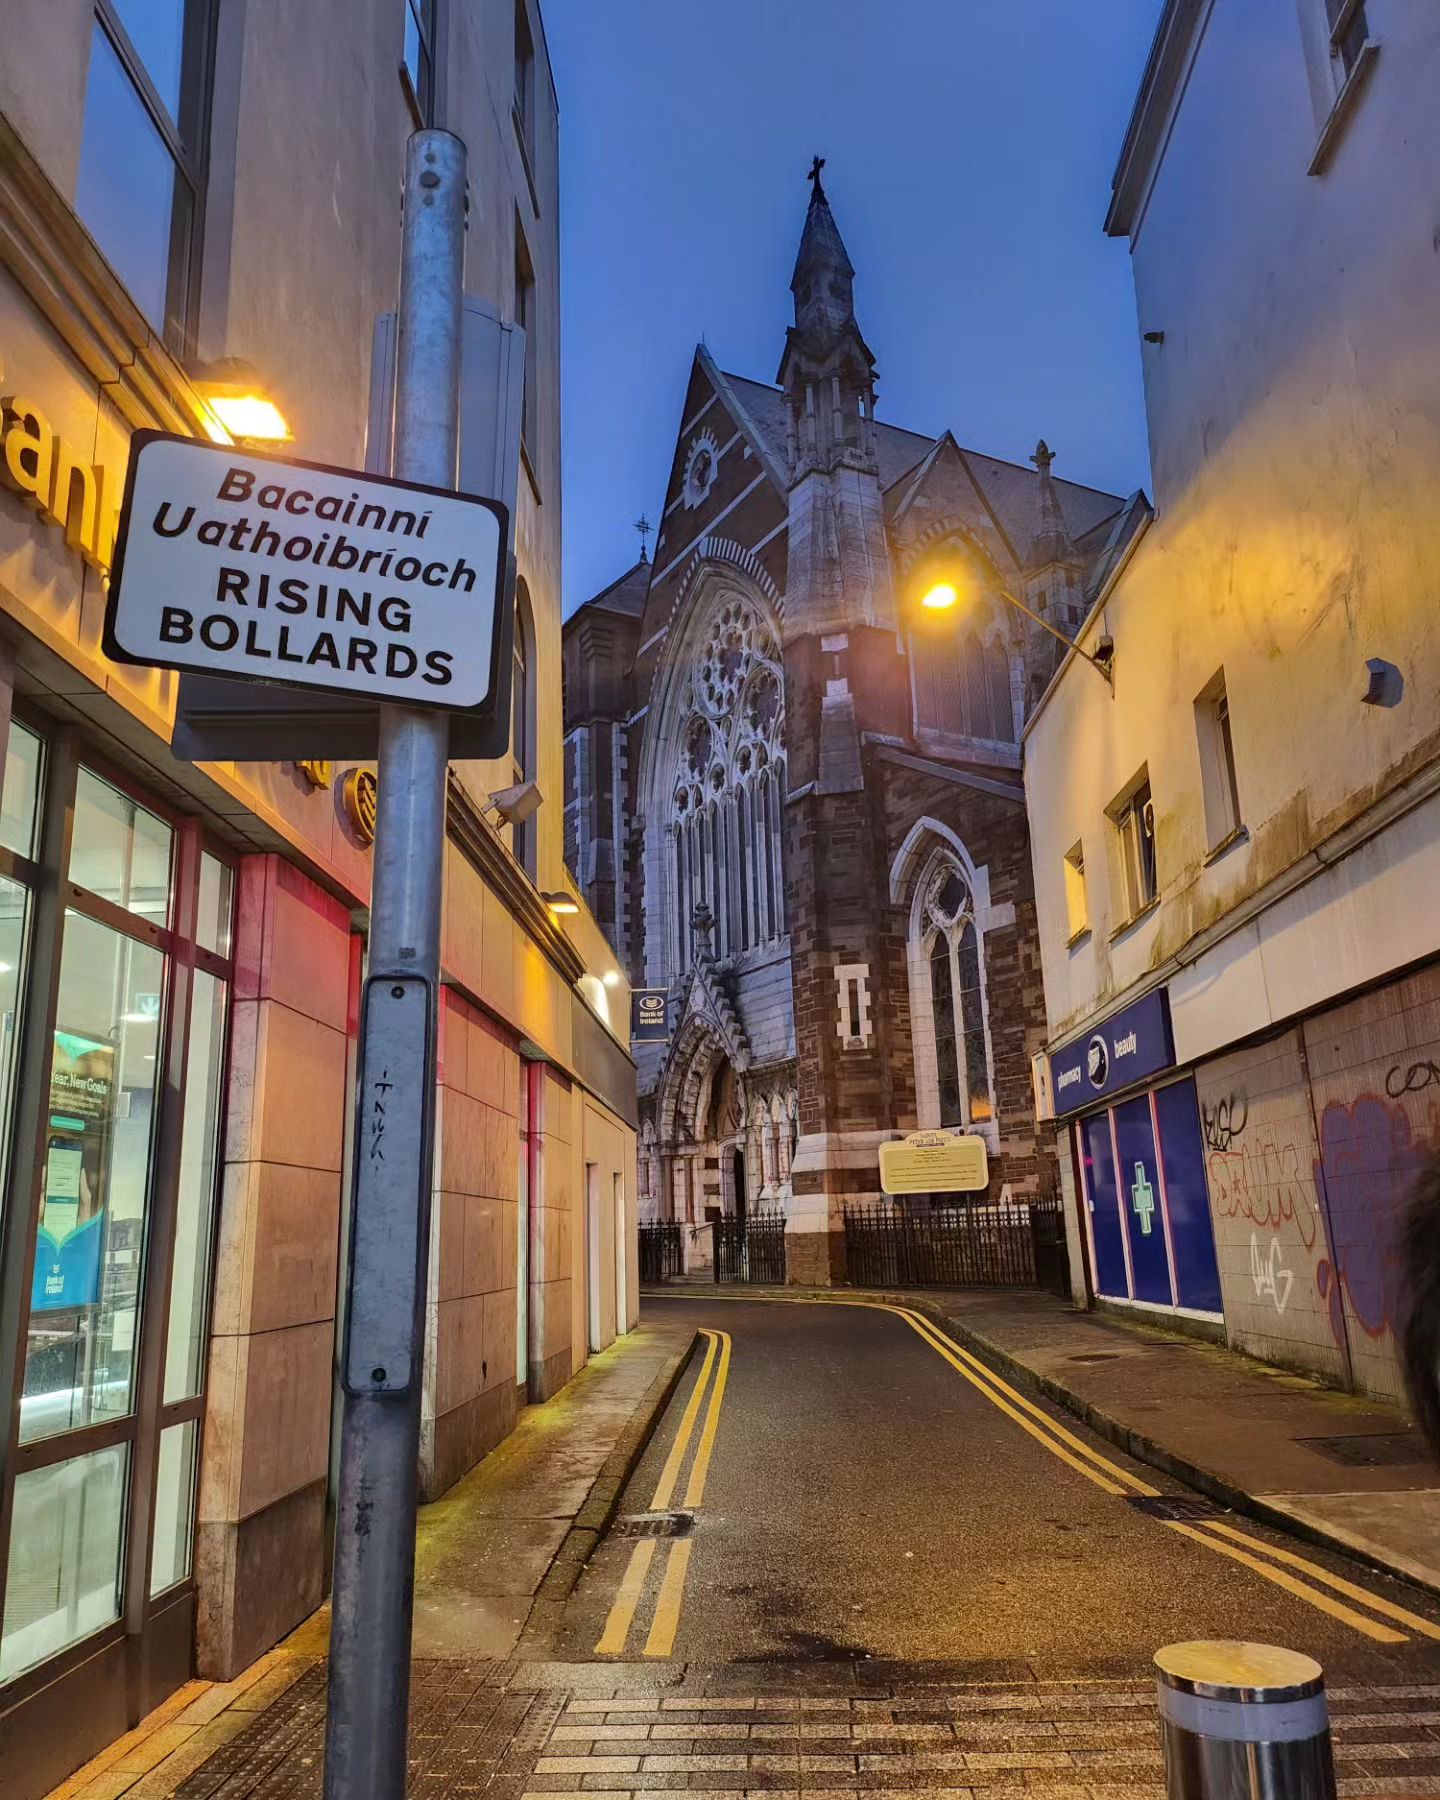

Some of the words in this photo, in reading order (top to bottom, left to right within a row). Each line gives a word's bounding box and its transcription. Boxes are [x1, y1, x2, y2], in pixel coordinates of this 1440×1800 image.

[217, 467, 433, 539] Bacainní
[152, 502, 477, 593] Uathoibríoch
[217, 567, 413, 634] RISING
[159, 606, 454, 686] BOLLARDS
[640, 1017, 664, 1025] Ireland
[1113, 1031, 1137, 1059] beauty
[70, 1073, 87, 1090] New
[87, 1077, 108, 1095] Goals
[1057, 1065, 1081, 1094] pharmacy
